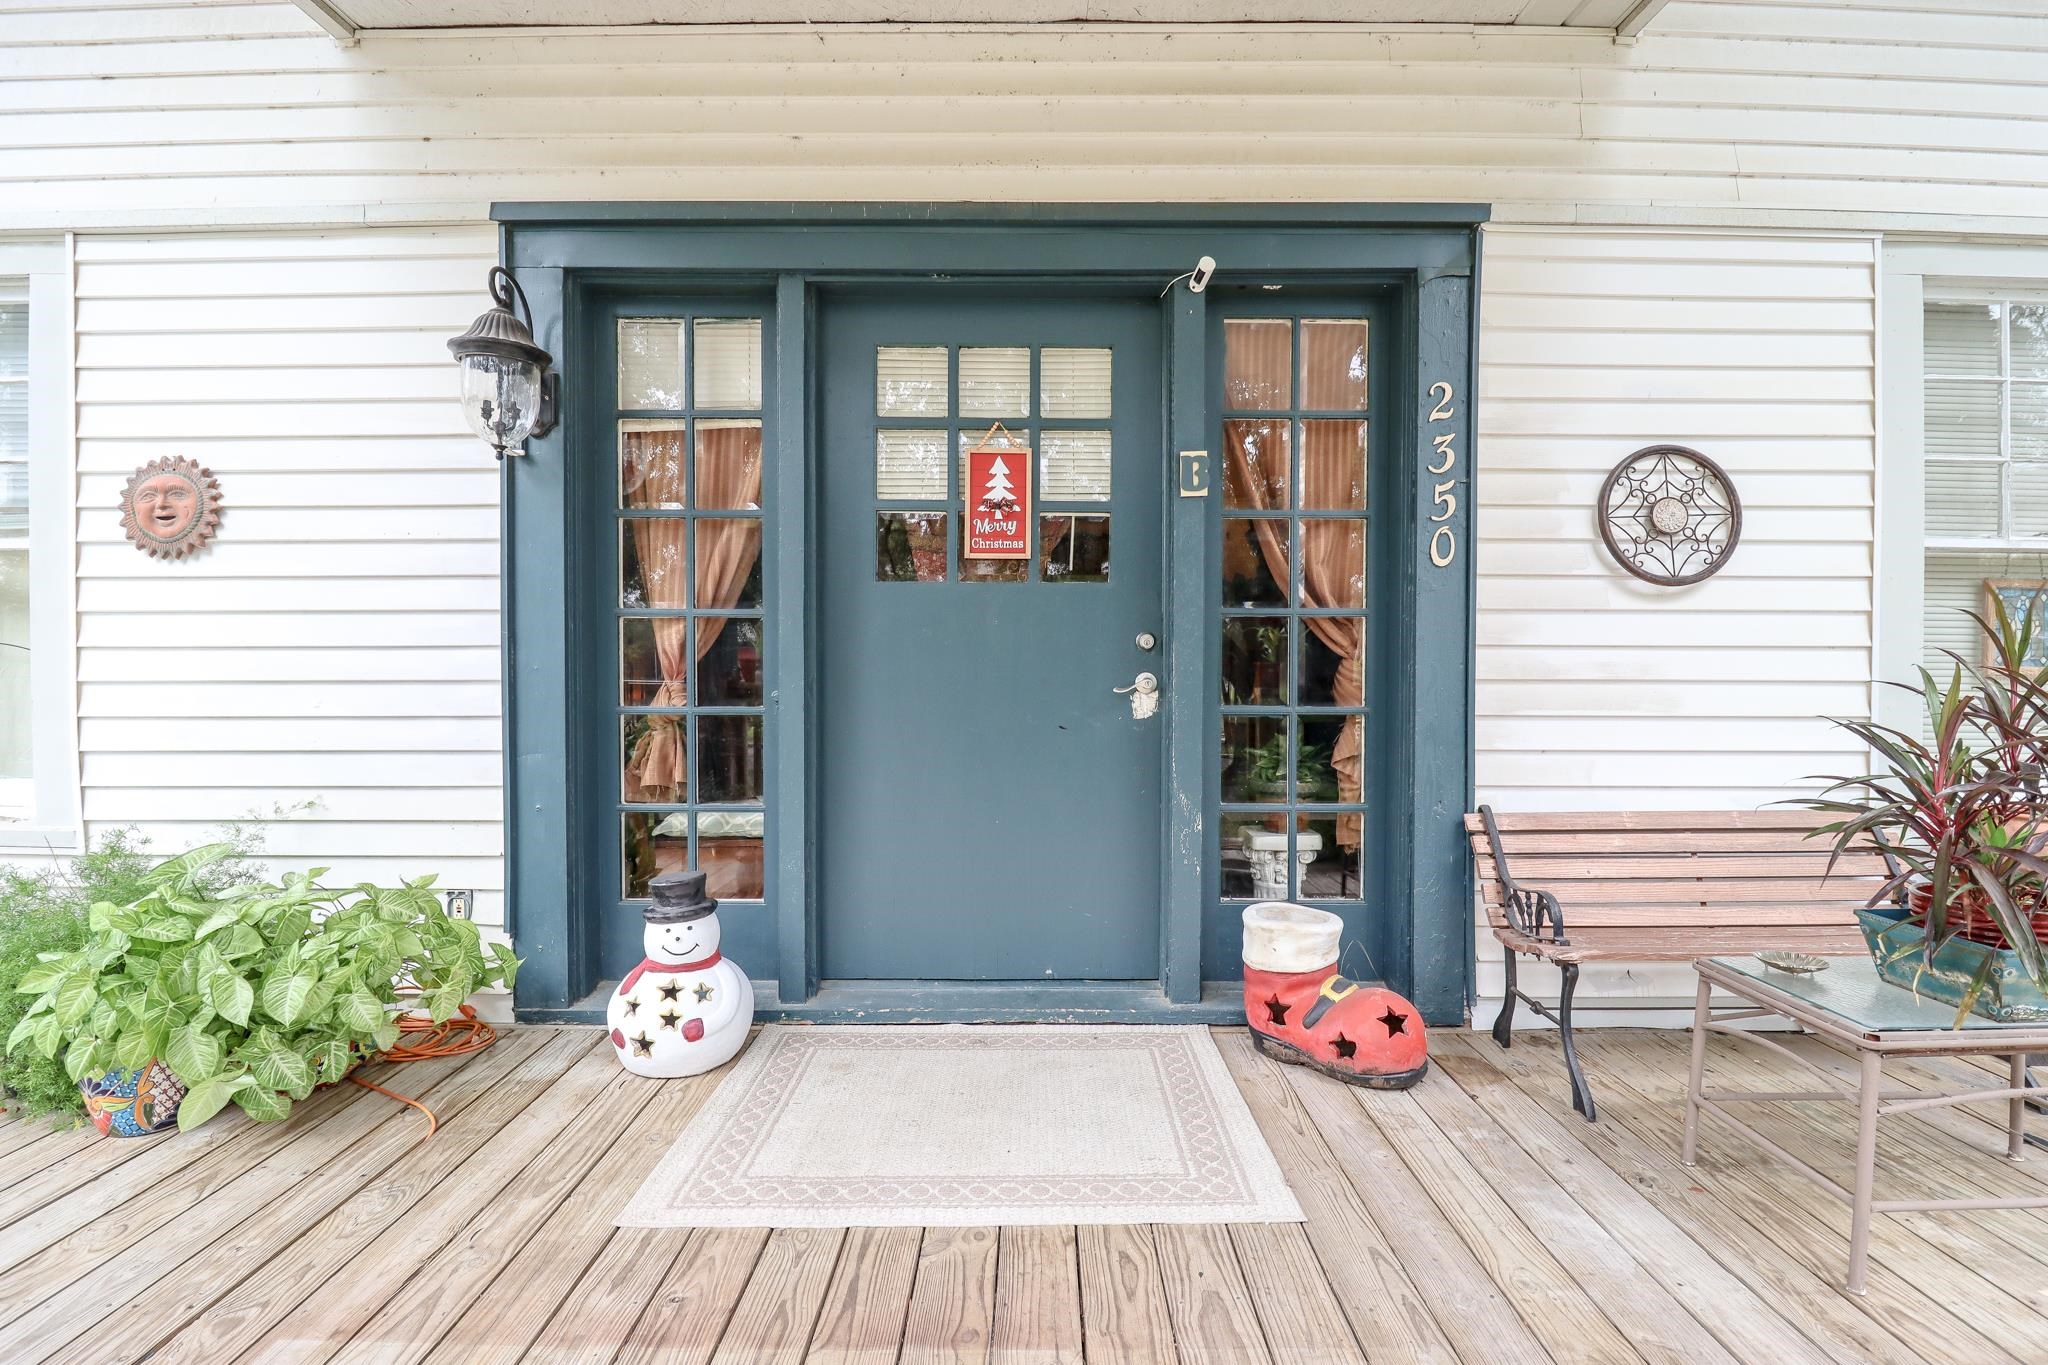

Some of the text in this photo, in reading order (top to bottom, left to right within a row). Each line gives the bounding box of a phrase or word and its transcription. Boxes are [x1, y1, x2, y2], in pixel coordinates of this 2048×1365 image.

[1427, 381, 1456, 567] 2350
[973, 518, 1017, 535] Merry
[971, 537, 1024, 549] Christmas
